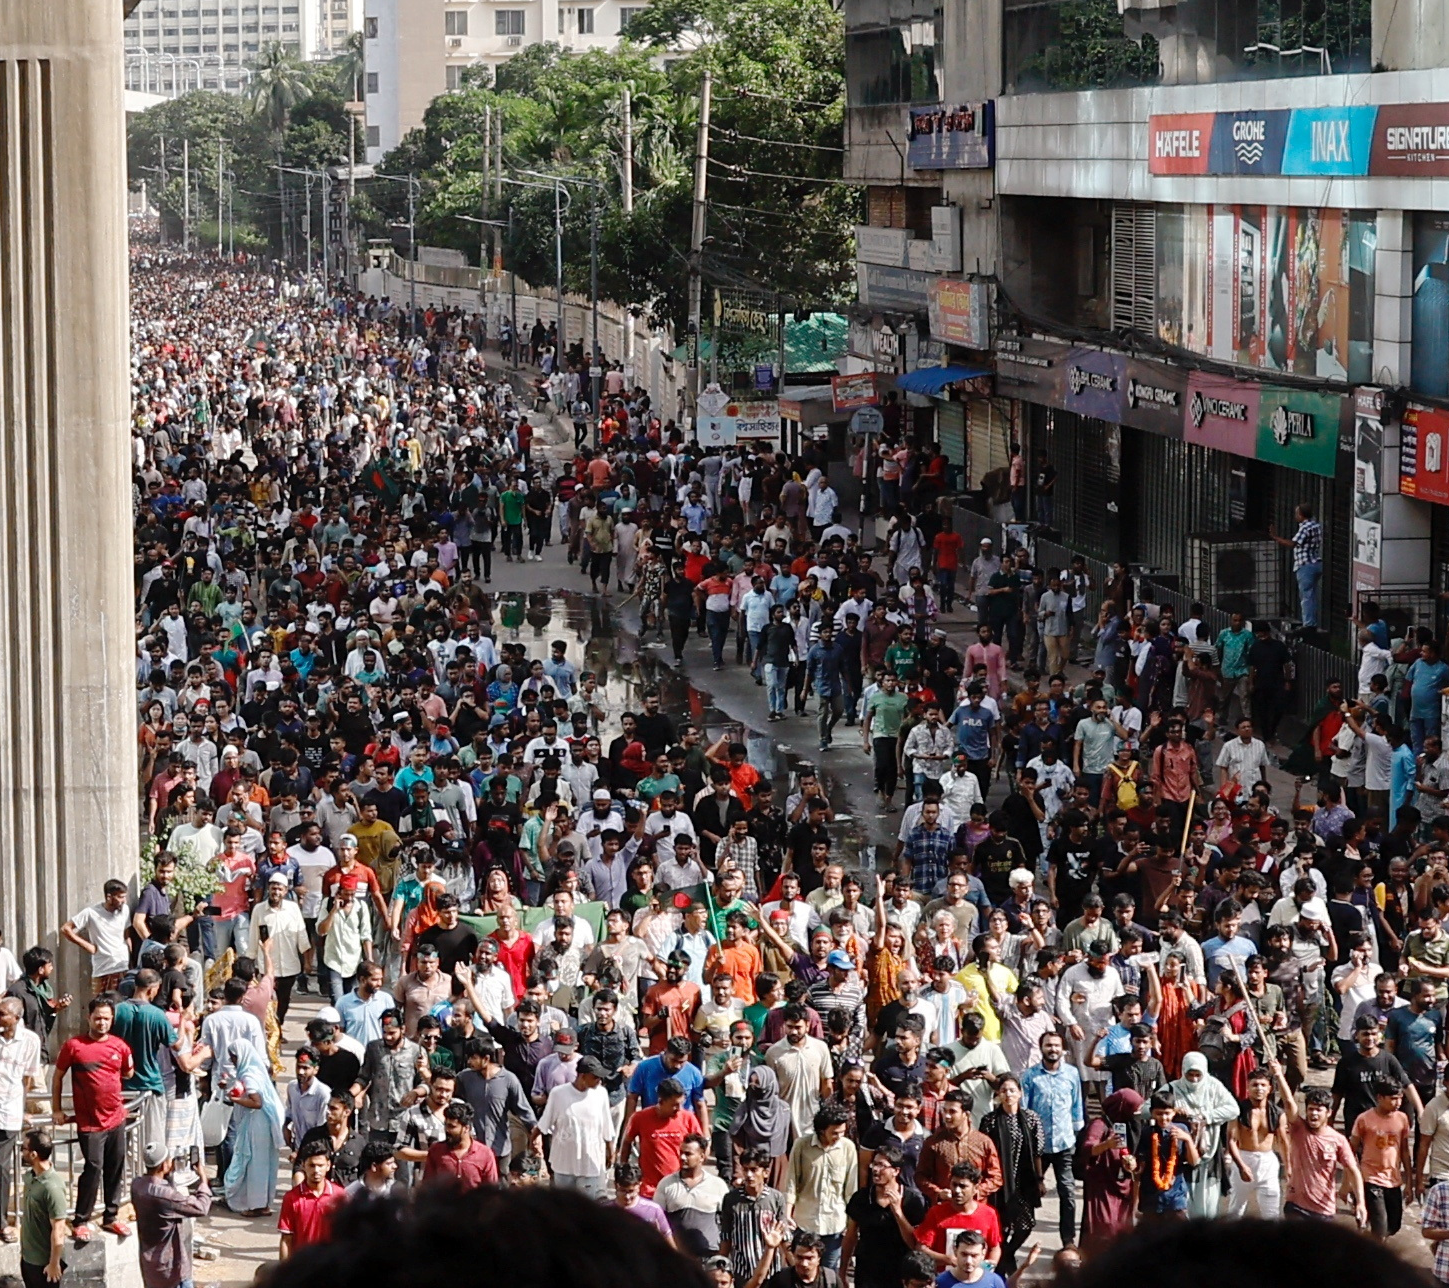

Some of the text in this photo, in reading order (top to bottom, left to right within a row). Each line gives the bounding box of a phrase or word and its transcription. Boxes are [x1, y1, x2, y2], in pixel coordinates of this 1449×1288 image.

[1233, 119, 1265, 141] GROHE
[1311, 120, 1351, 163] INAX
[1155, 130, 1200, 158] HÄFELE
[1406, 153, 1436, 162] KITCHEN
[1288, 412, 1312, 438] PERLA
